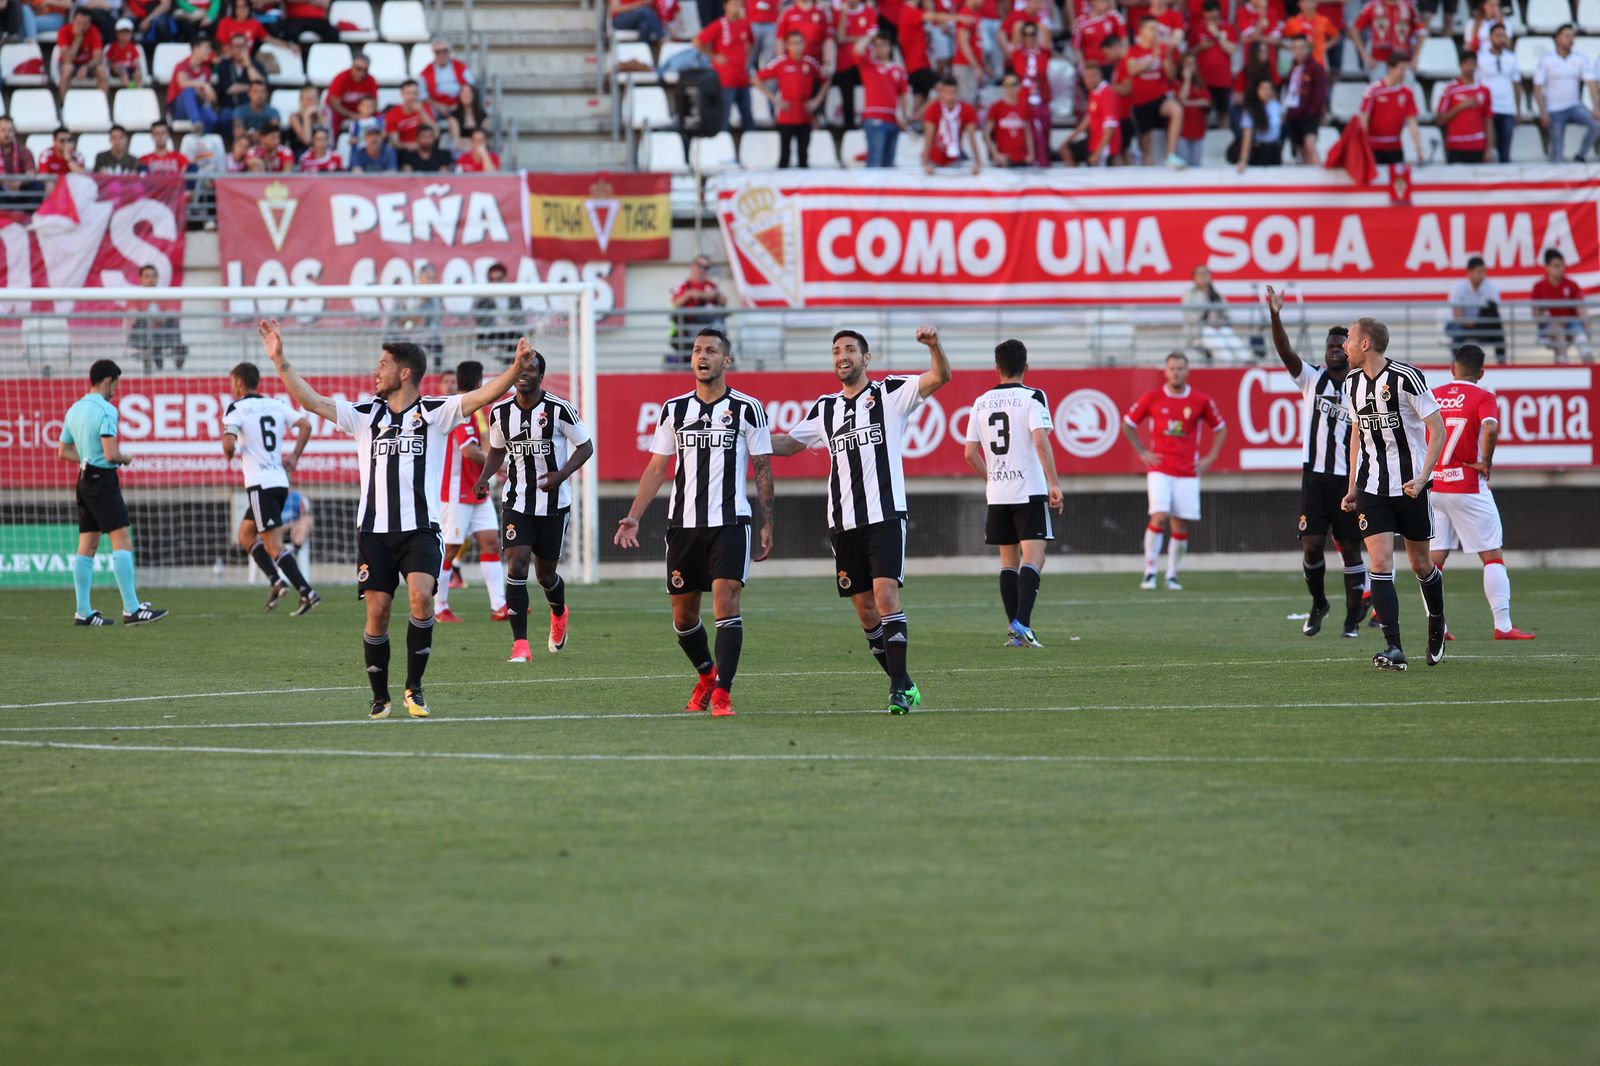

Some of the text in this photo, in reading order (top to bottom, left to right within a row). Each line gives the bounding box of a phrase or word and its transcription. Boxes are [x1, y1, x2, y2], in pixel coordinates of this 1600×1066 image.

[330, 183, 510, 246] PEÑA
[816, 216, 1007, 278] COMO
[1036, 215, 1172, 275] UNA
[1203, 214, 1374, 273] SOLA
[1405, 209, 1581, 270] ALMA
[227, 257, 325, 323] LOS
[259, 415, 276, 452] 6
[988, 411, 1011, 456] 3
[1358, 414, 1400, 430] OTUS
[372, 438, 424, 459] LOTUS
[676, 433, 735, 451] LOTUS
[830, 427, 883, 456] LOTUS
